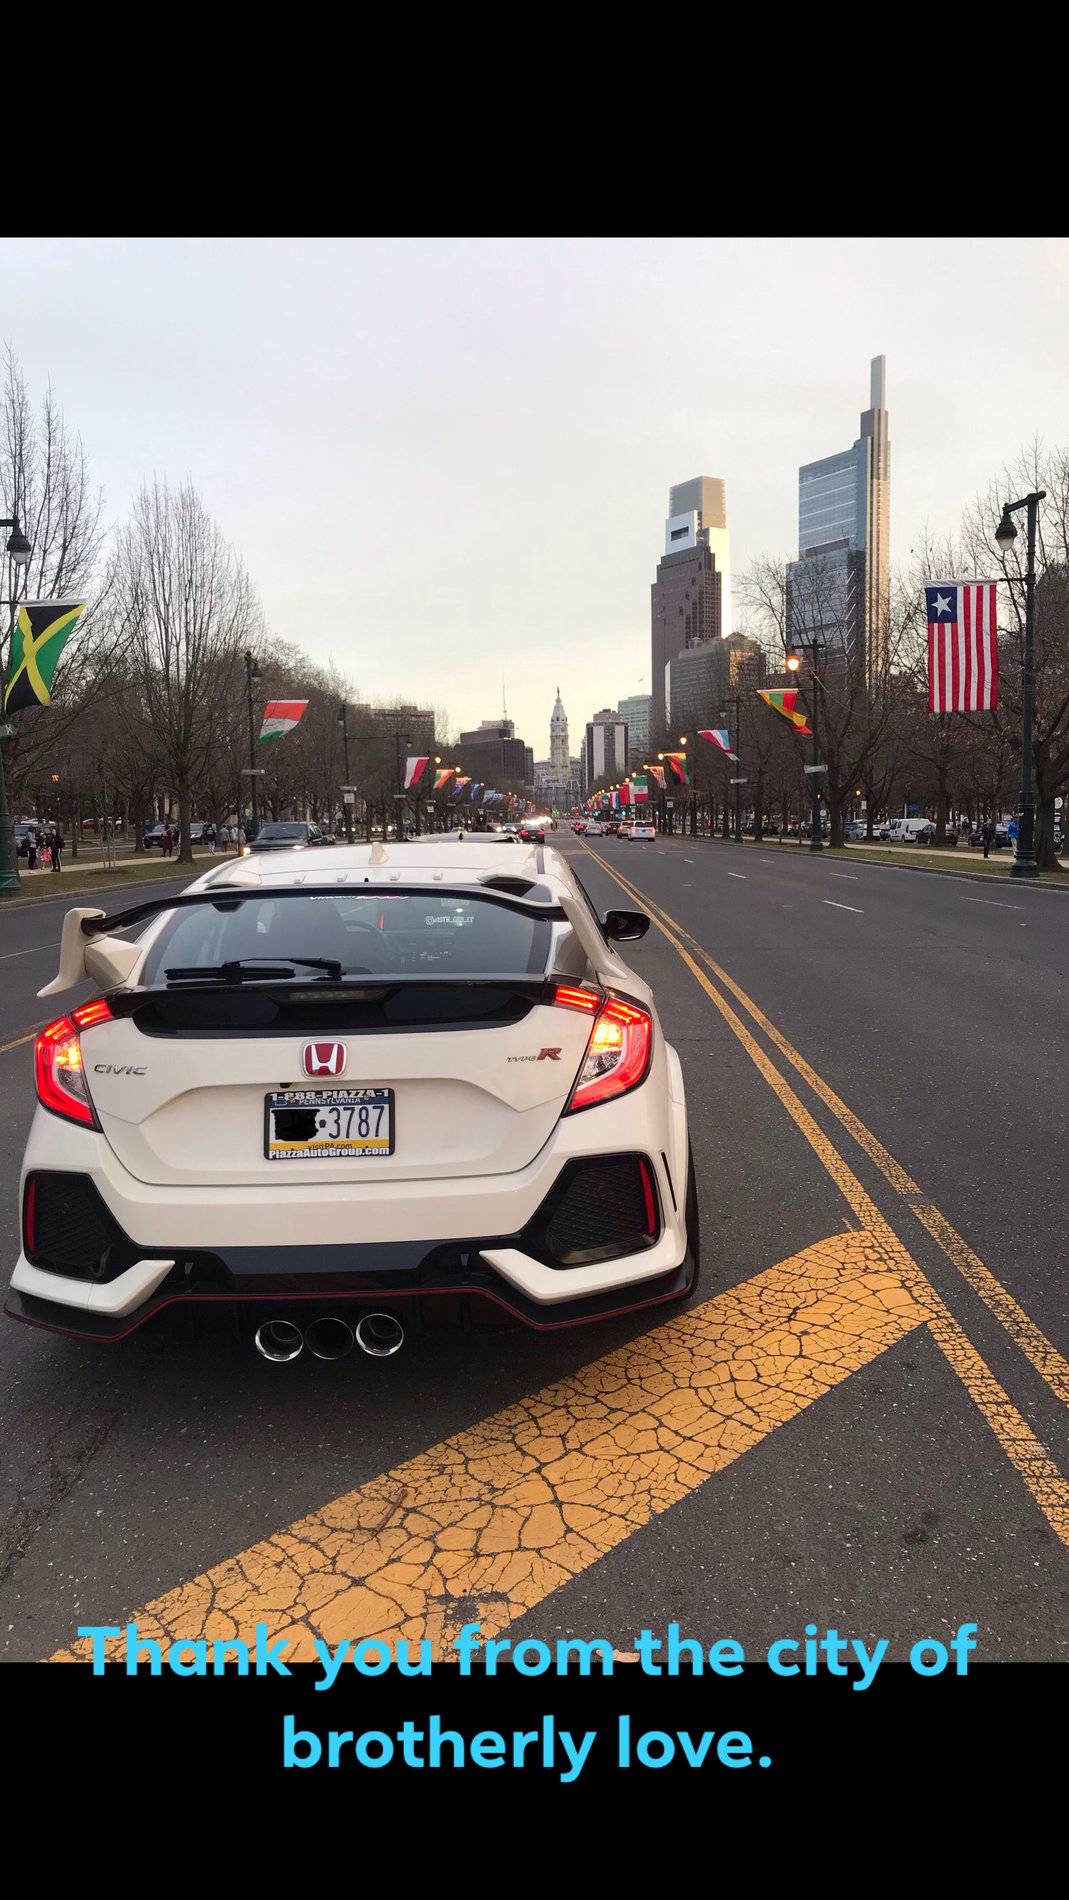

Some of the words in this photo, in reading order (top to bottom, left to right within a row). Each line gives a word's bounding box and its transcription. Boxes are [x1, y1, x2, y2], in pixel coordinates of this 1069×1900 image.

[536, 1047, 562, 1061] R
[94, 1064, 148, 1075] CIVIC
[298, 1097, 361, 1106] PENNSYLVANIA
[328, 1105, 385, 1140] 3787
[268, 1147, 390, 1159] PiazzaAutoGroup.com
